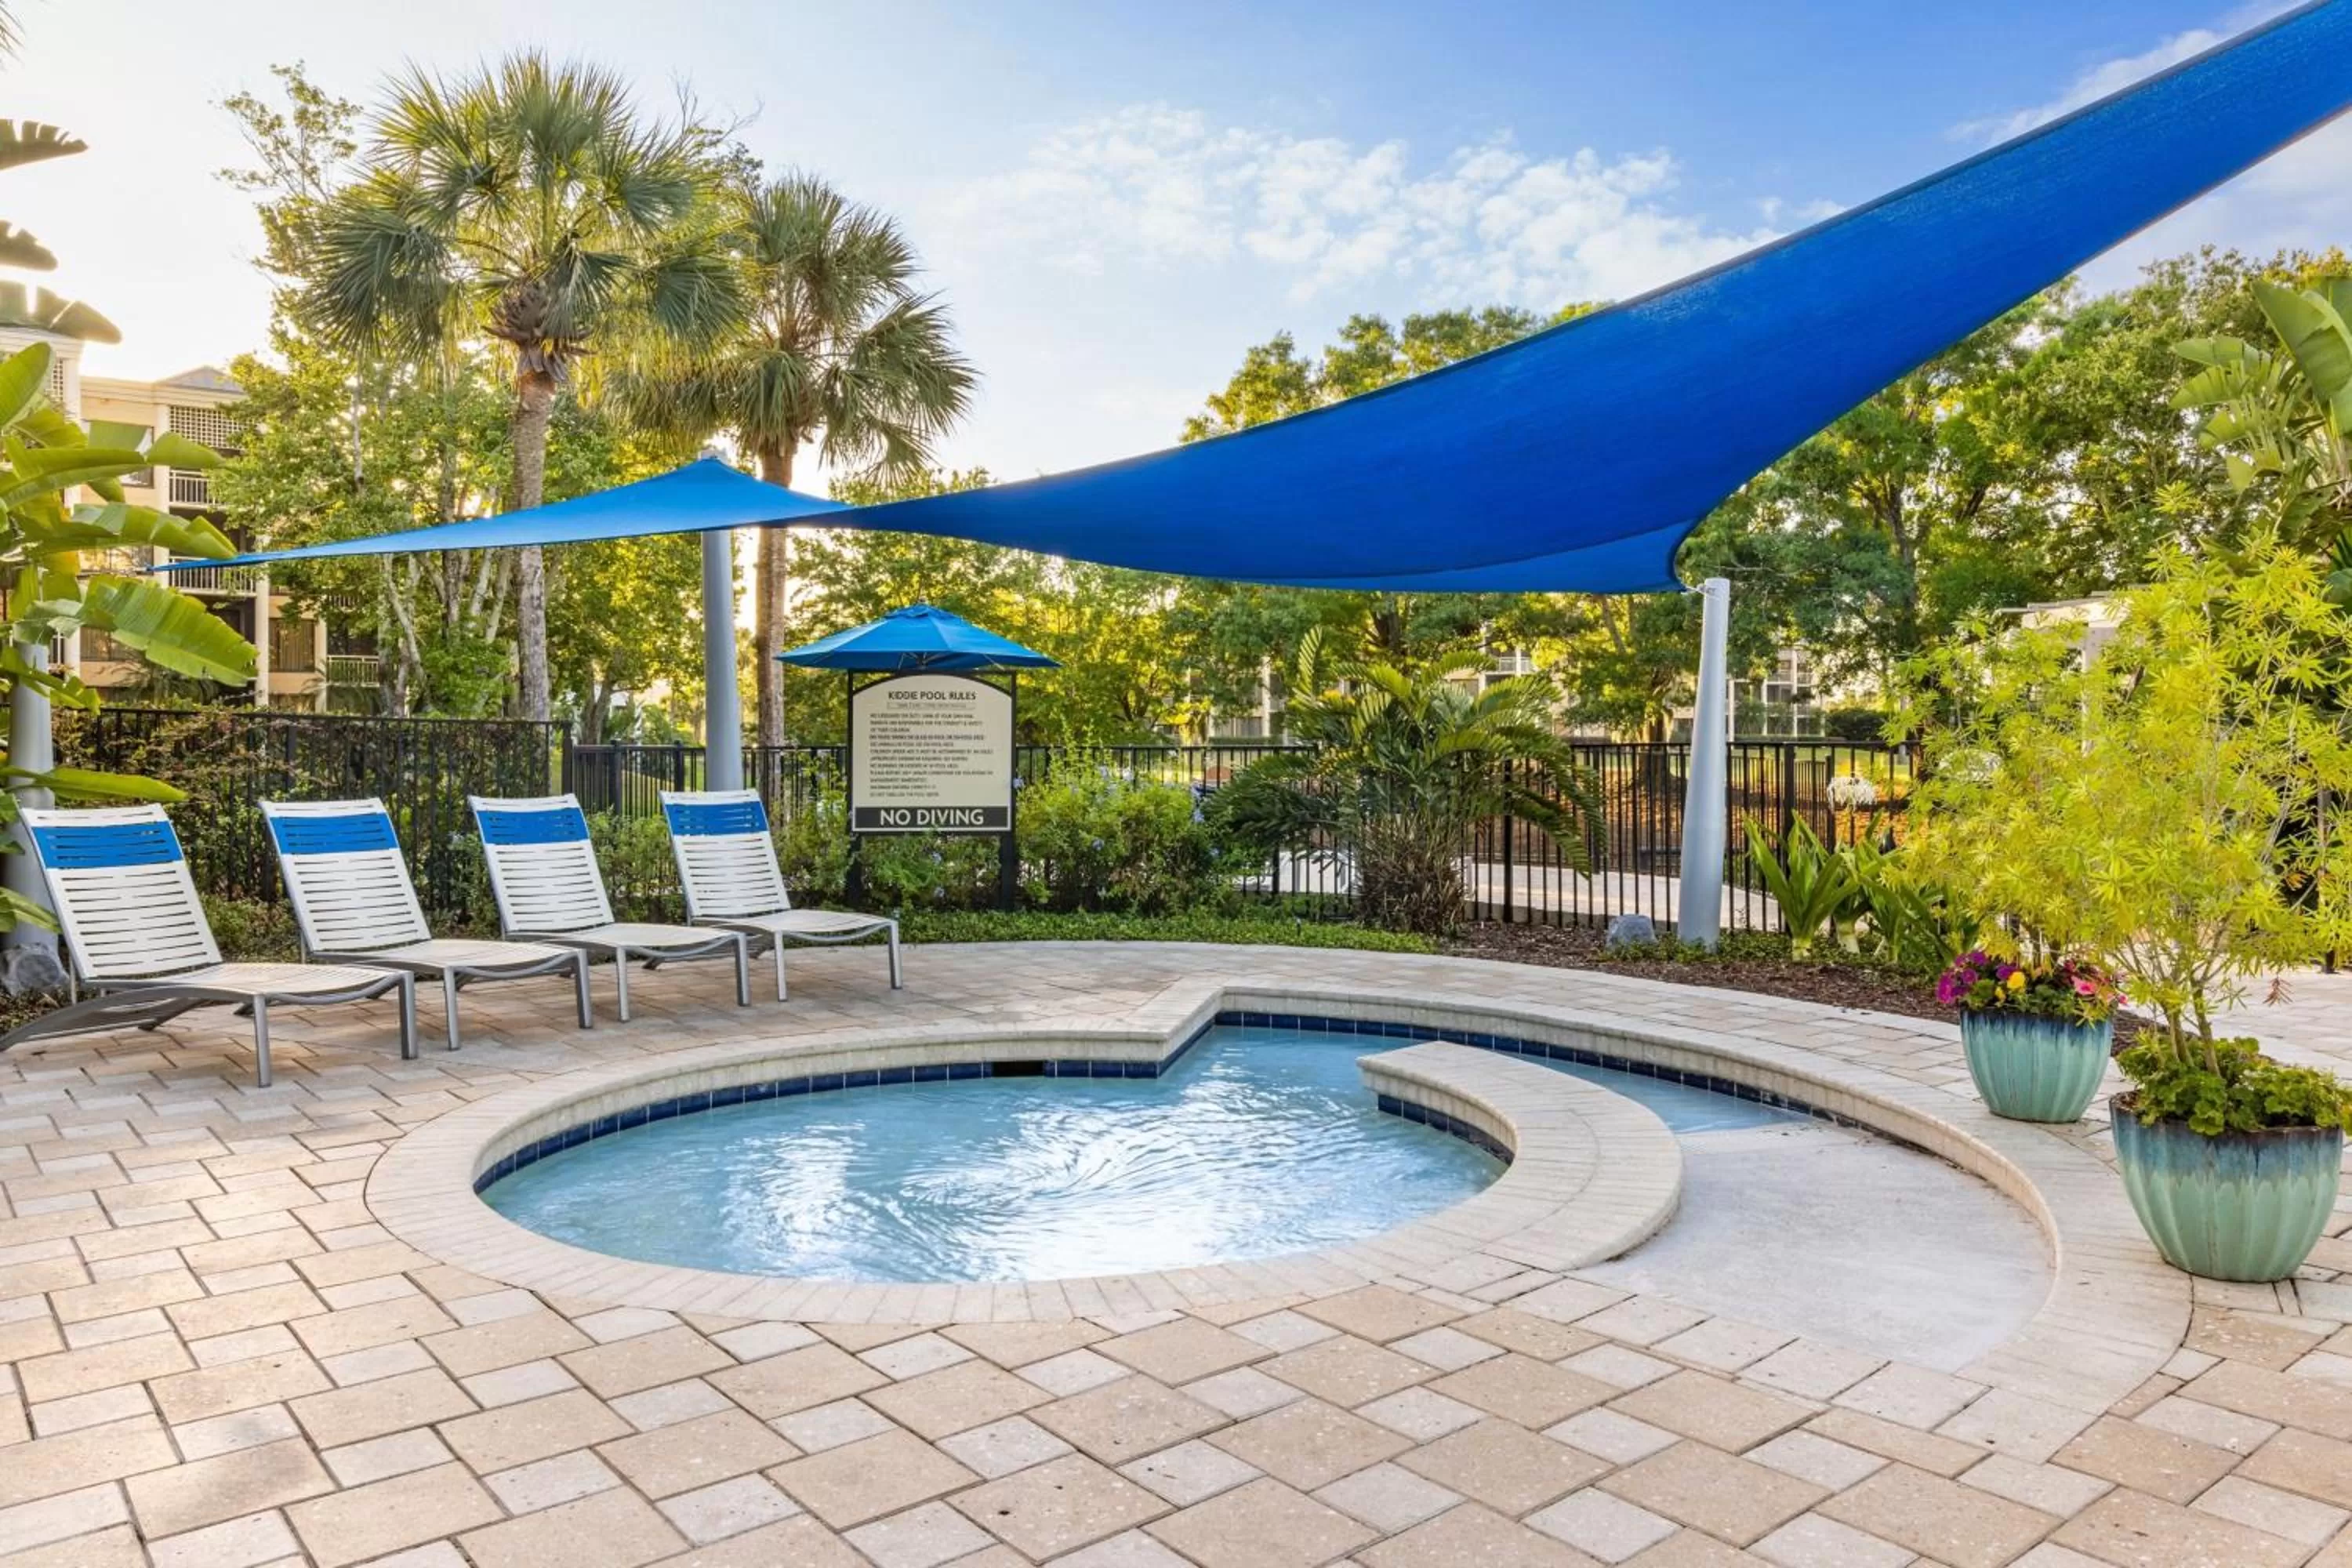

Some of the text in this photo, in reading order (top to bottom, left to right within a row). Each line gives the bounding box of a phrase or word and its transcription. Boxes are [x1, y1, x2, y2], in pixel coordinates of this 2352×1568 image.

[887, 691, 976, 700] KIDDIE POOL RULES
[880, 809, 984, 826] NO DIVING
